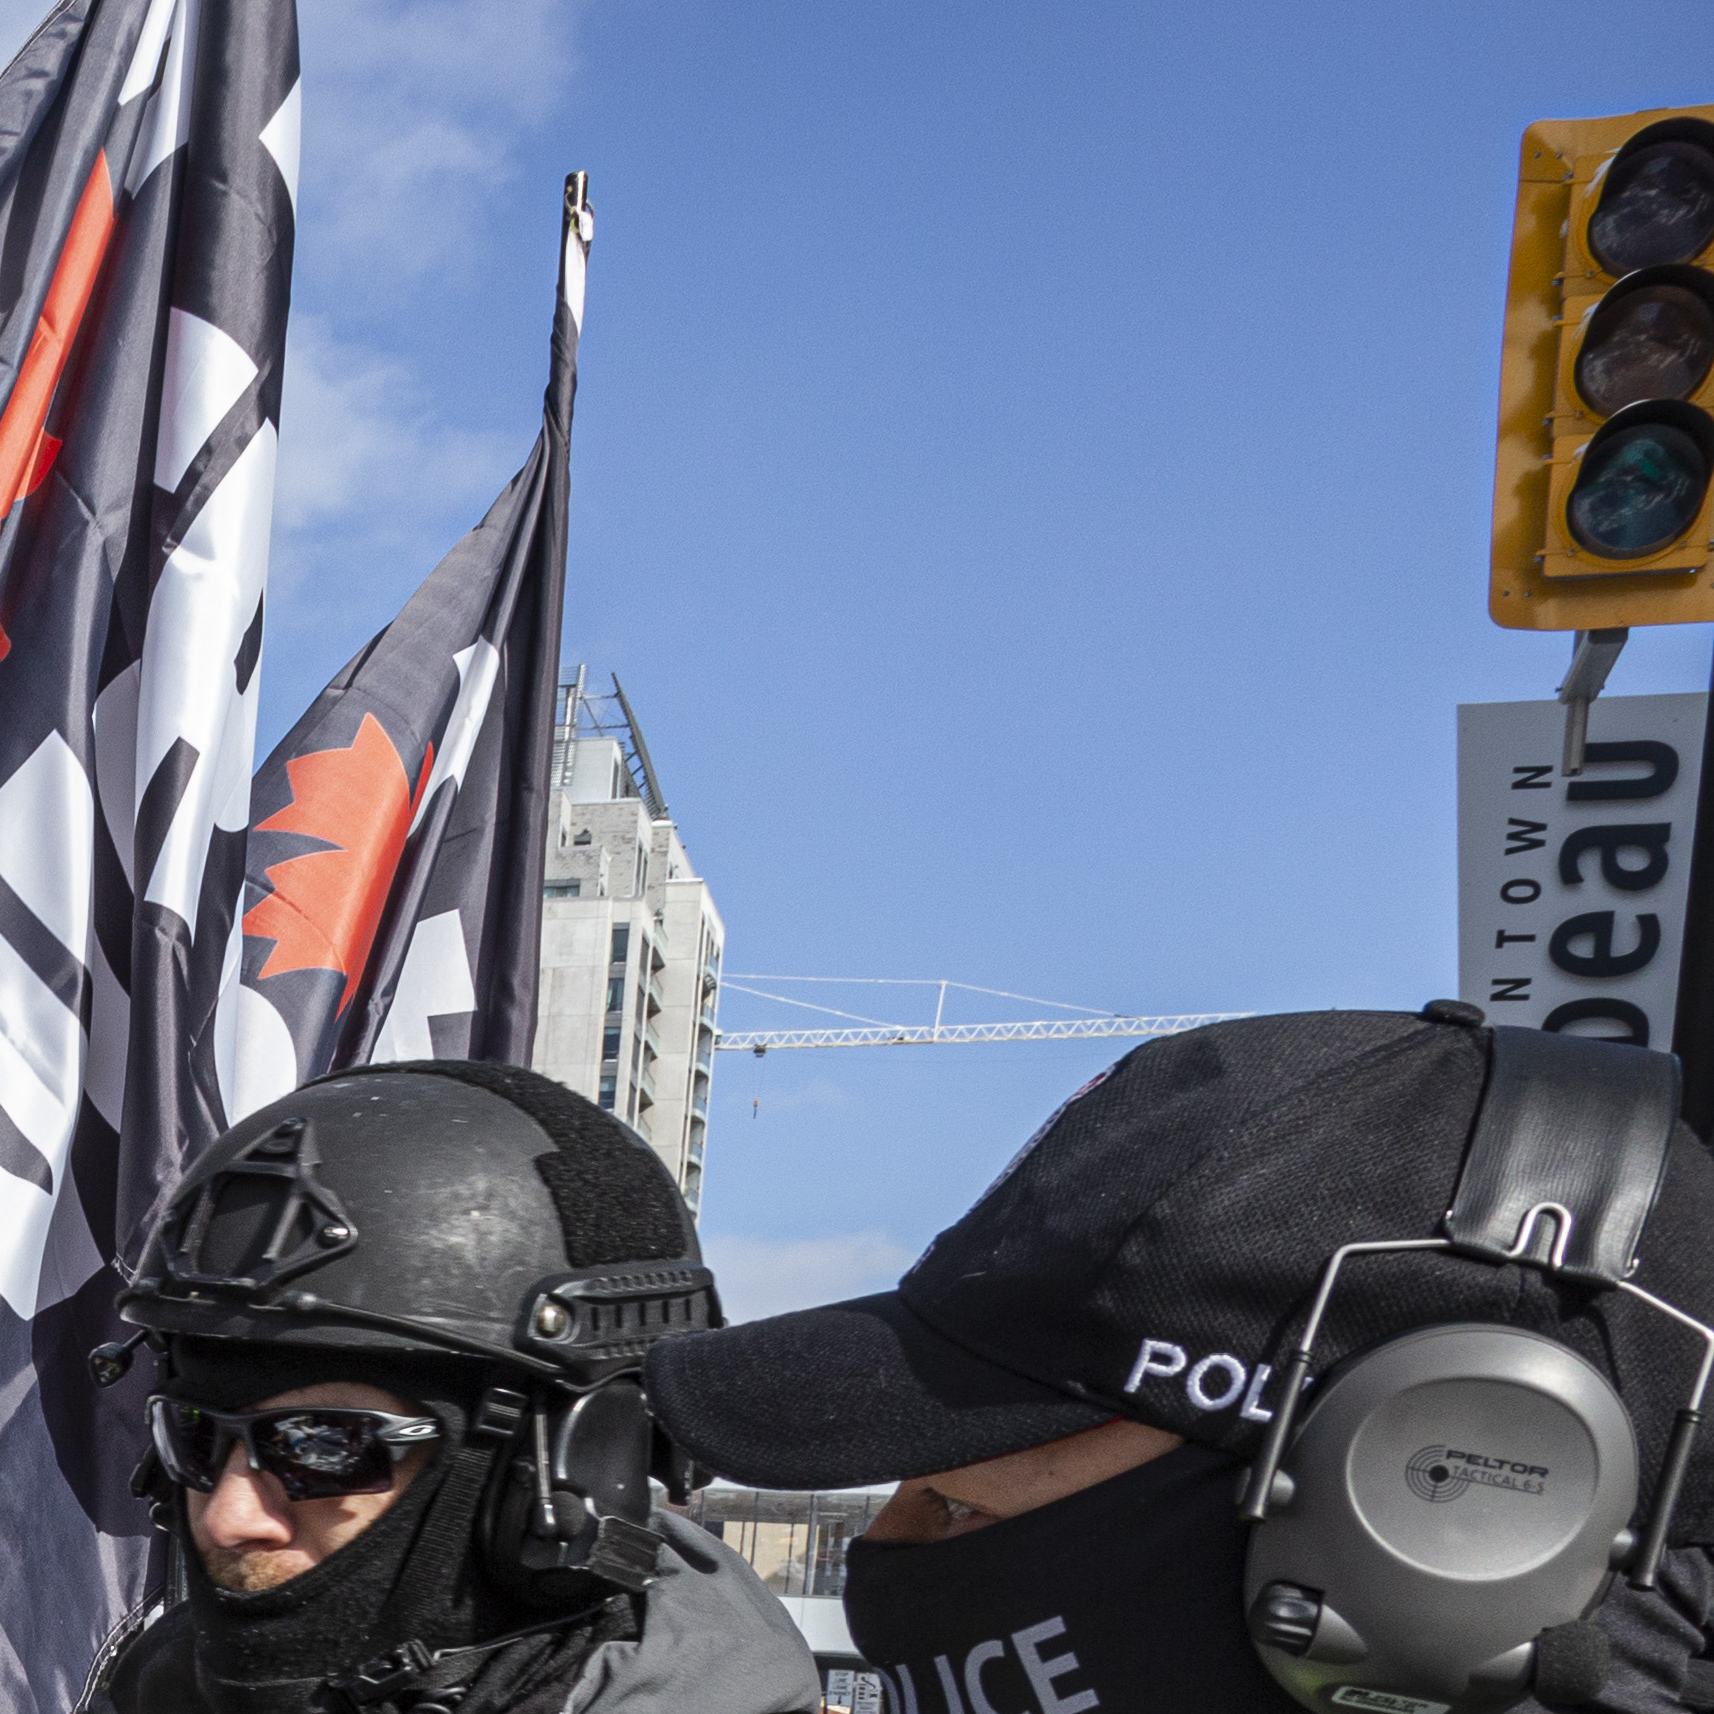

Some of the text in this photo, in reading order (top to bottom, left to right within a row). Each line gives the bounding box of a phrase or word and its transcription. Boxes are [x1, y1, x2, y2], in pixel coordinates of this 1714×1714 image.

[1123, 1337, 1313, 1422] POL
[1446, 1449, 1549, 1479] PELTOR
[1453, 1465, 1520, 1488] TACTICAL
